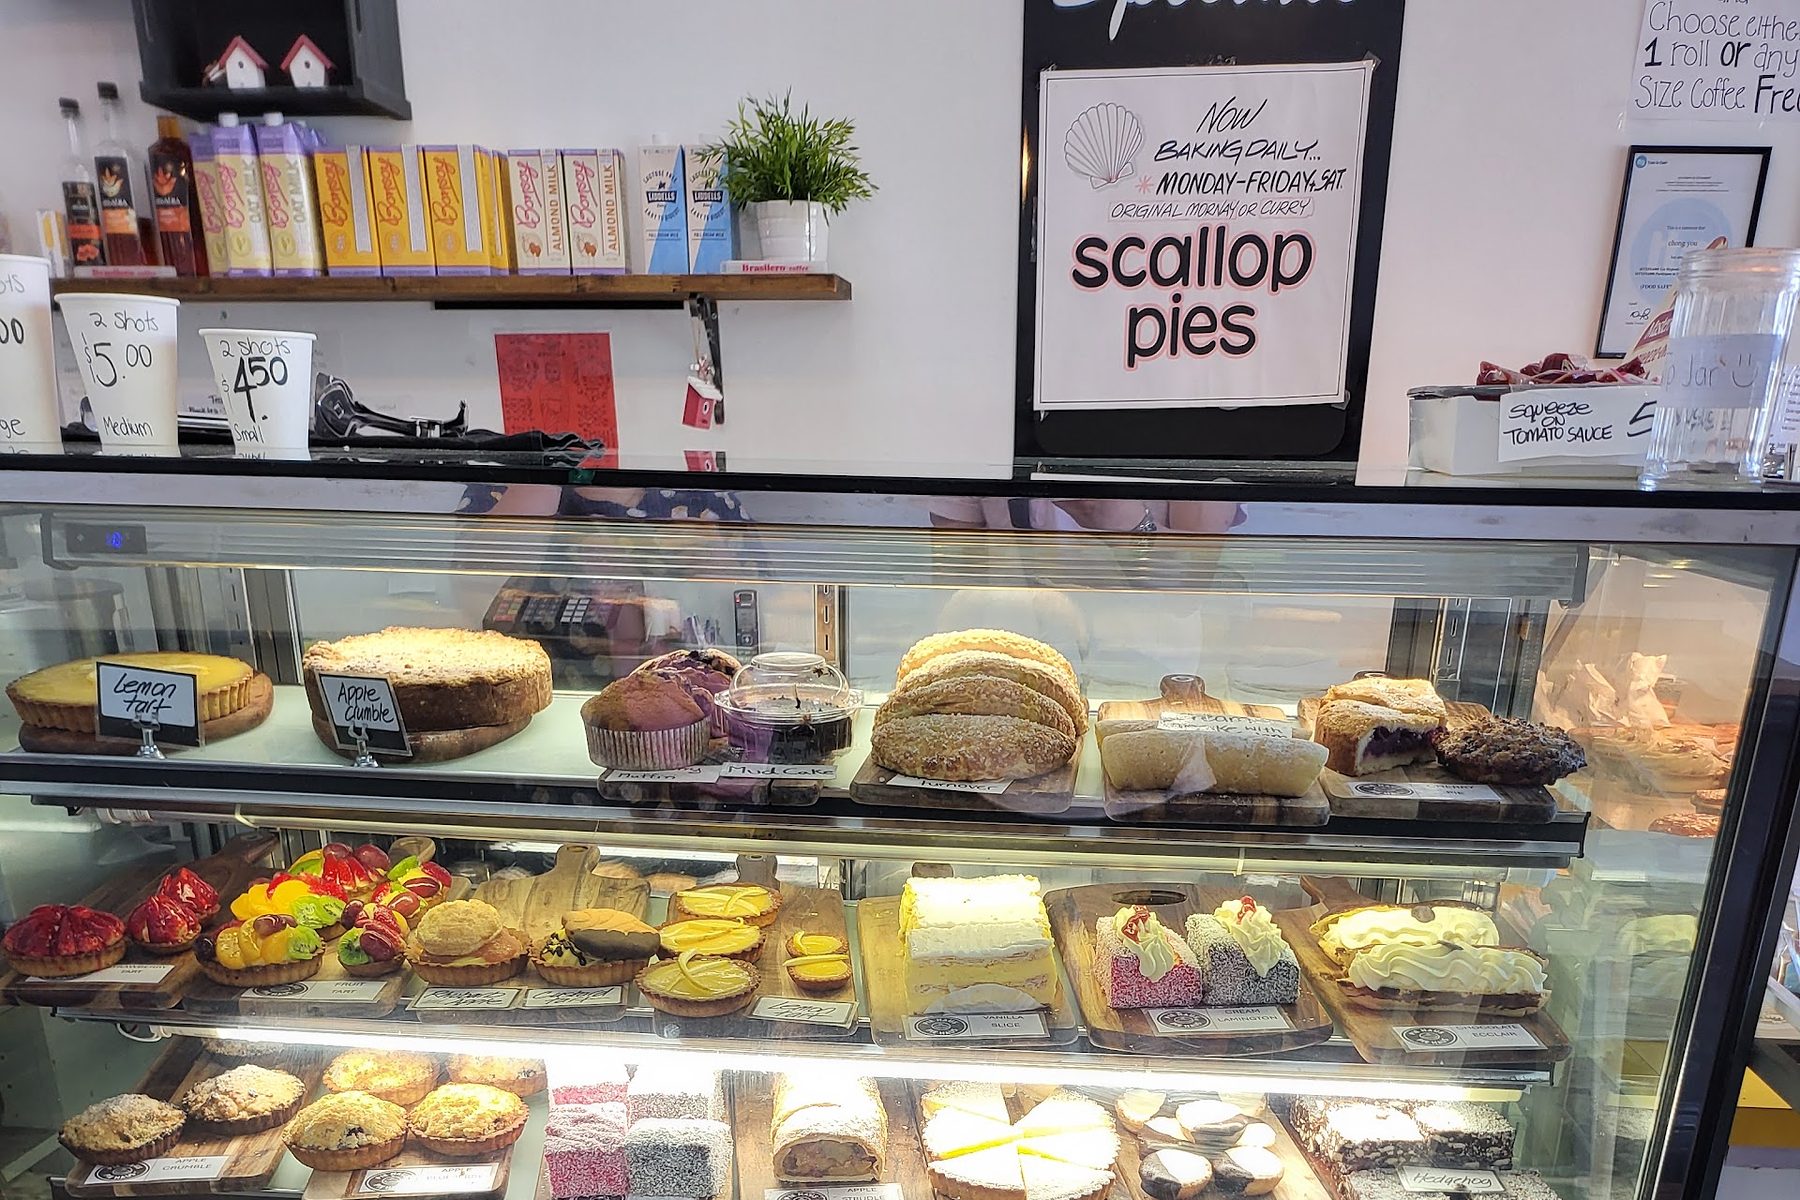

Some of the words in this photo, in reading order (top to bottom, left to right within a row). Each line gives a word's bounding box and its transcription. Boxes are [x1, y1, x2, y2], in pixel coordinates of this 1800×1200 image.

[1649, 1, 1741, 37] Choose
[1745, 15, 1800, 42] eithe
[1644, 37, 1663, 67] 1
[1670, 39, 1710, 66] roll
[1720, 41, 1752, 68] or
[1753, 43, 1800, 78] any
[1690, 77, 1746, 110] Coffee
[1154, 139, 1242, 166] BAKING
[545, 164, 558, 195] MILK
[602, 164, 615, 195] MILK
[1111, 203, 1183, 218] ORIGINAL
[1185, 200, 1237, 218] MORNAY
[1238, 202, 1258, 217] OR
[1260, 199, 1311, 216] CURRY
[549, 199, 563, 251] ALMOND
[605, 199, 619, 251] ALMOND
[1071, 225, 1314, 293] scallop
[89, 312, 107, 328] 2
[1126, 292, 1257, 369] pies
[220, 340, 235, 357] 2
[103, 416, 153, 437] Medium
[234, 423, 264, 443] Small
[1541, 416, 1566, 428] ON
[1503, 427, 1564, 445] TOMATO
[1567, 425, 1613, 443] SAUCE
[113, 673, 177, 698] Lemon
[337, 682, 380, 705] Apple
[728, 766, 777, 775] Mud
[782, 767, 835, 776] Cake
[768, 1001, 837, 1014] Lemon
[1217, 1015, 1278, 1023] LAMINGTON
